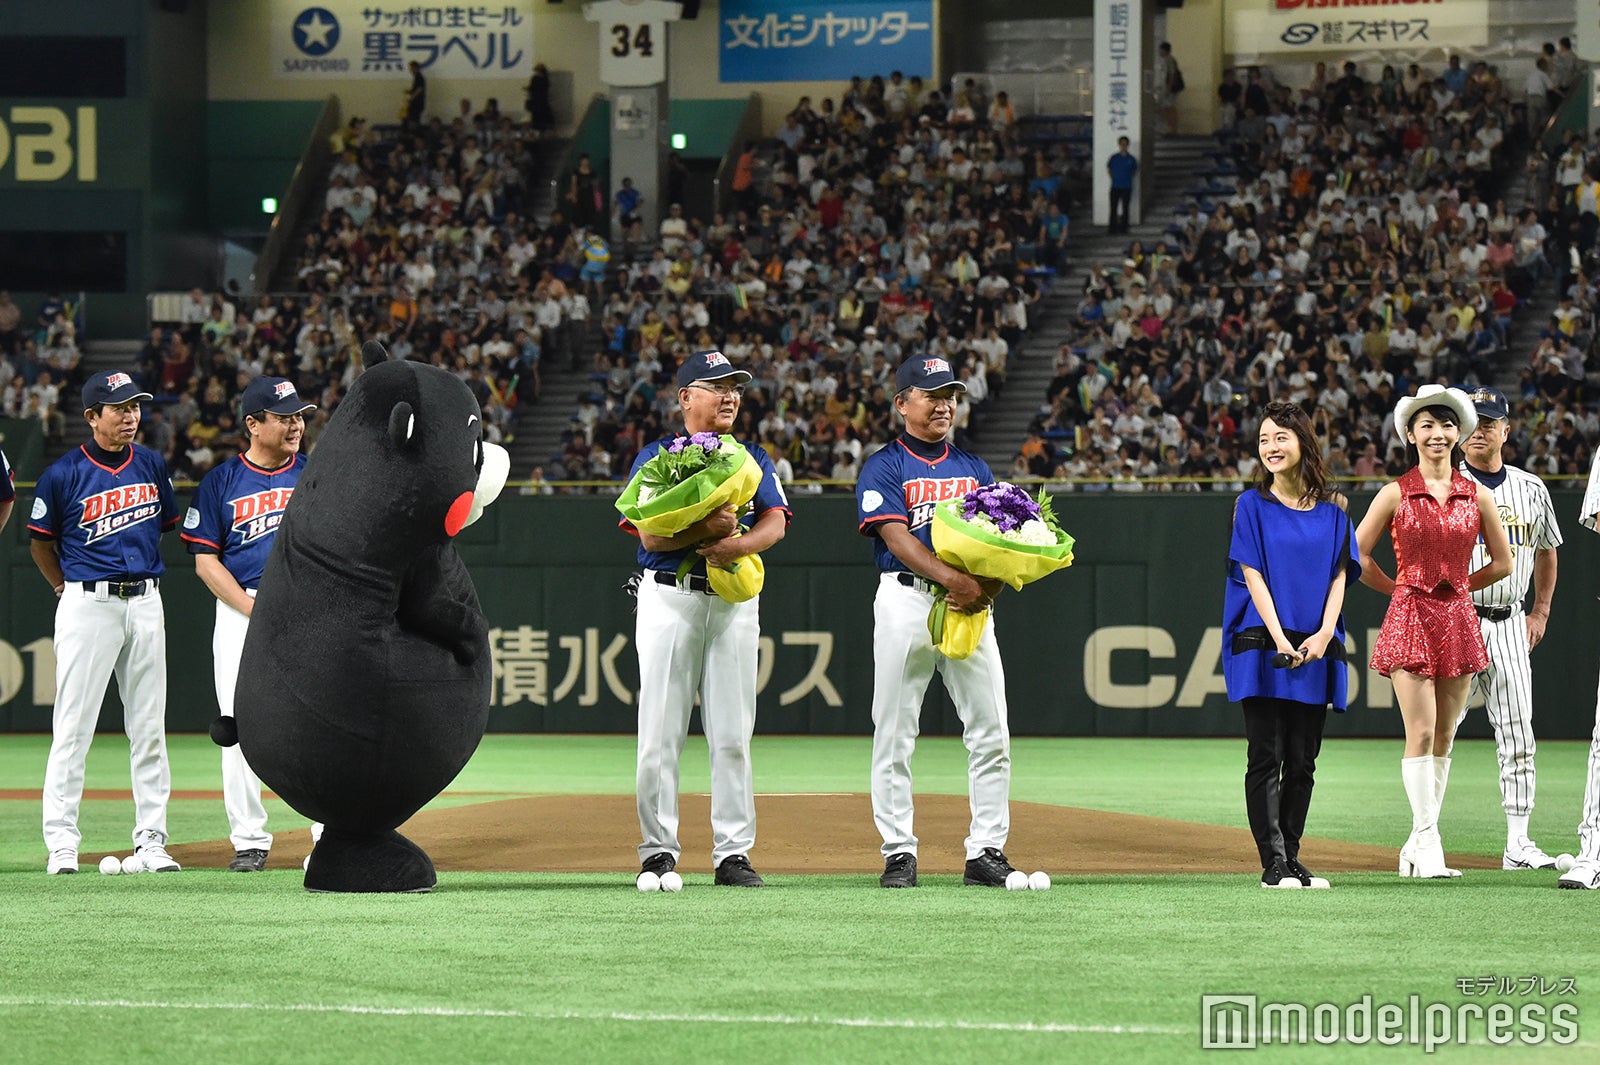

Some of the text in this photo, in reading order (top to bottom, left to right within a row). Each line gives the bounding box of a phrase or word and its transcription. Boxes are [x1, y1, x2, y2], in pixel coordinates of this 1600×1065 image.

[362, 7, 523, 27] サッポロ生ビール
[362, 32, 523, 71] 黒ラベル
[610, 23, 653, 57] 34
[283, 58, 349, 72] SAPPORO
[0, 105, 97, 182] BI
[82, 484, 160, 524] DREAM
[94, 504, 156, 539] Heroes
[233, 489, 294, 527] DRE
[488, 625, 844, 707] 積水ス
[1083, 625, 1488, 709] CAI
